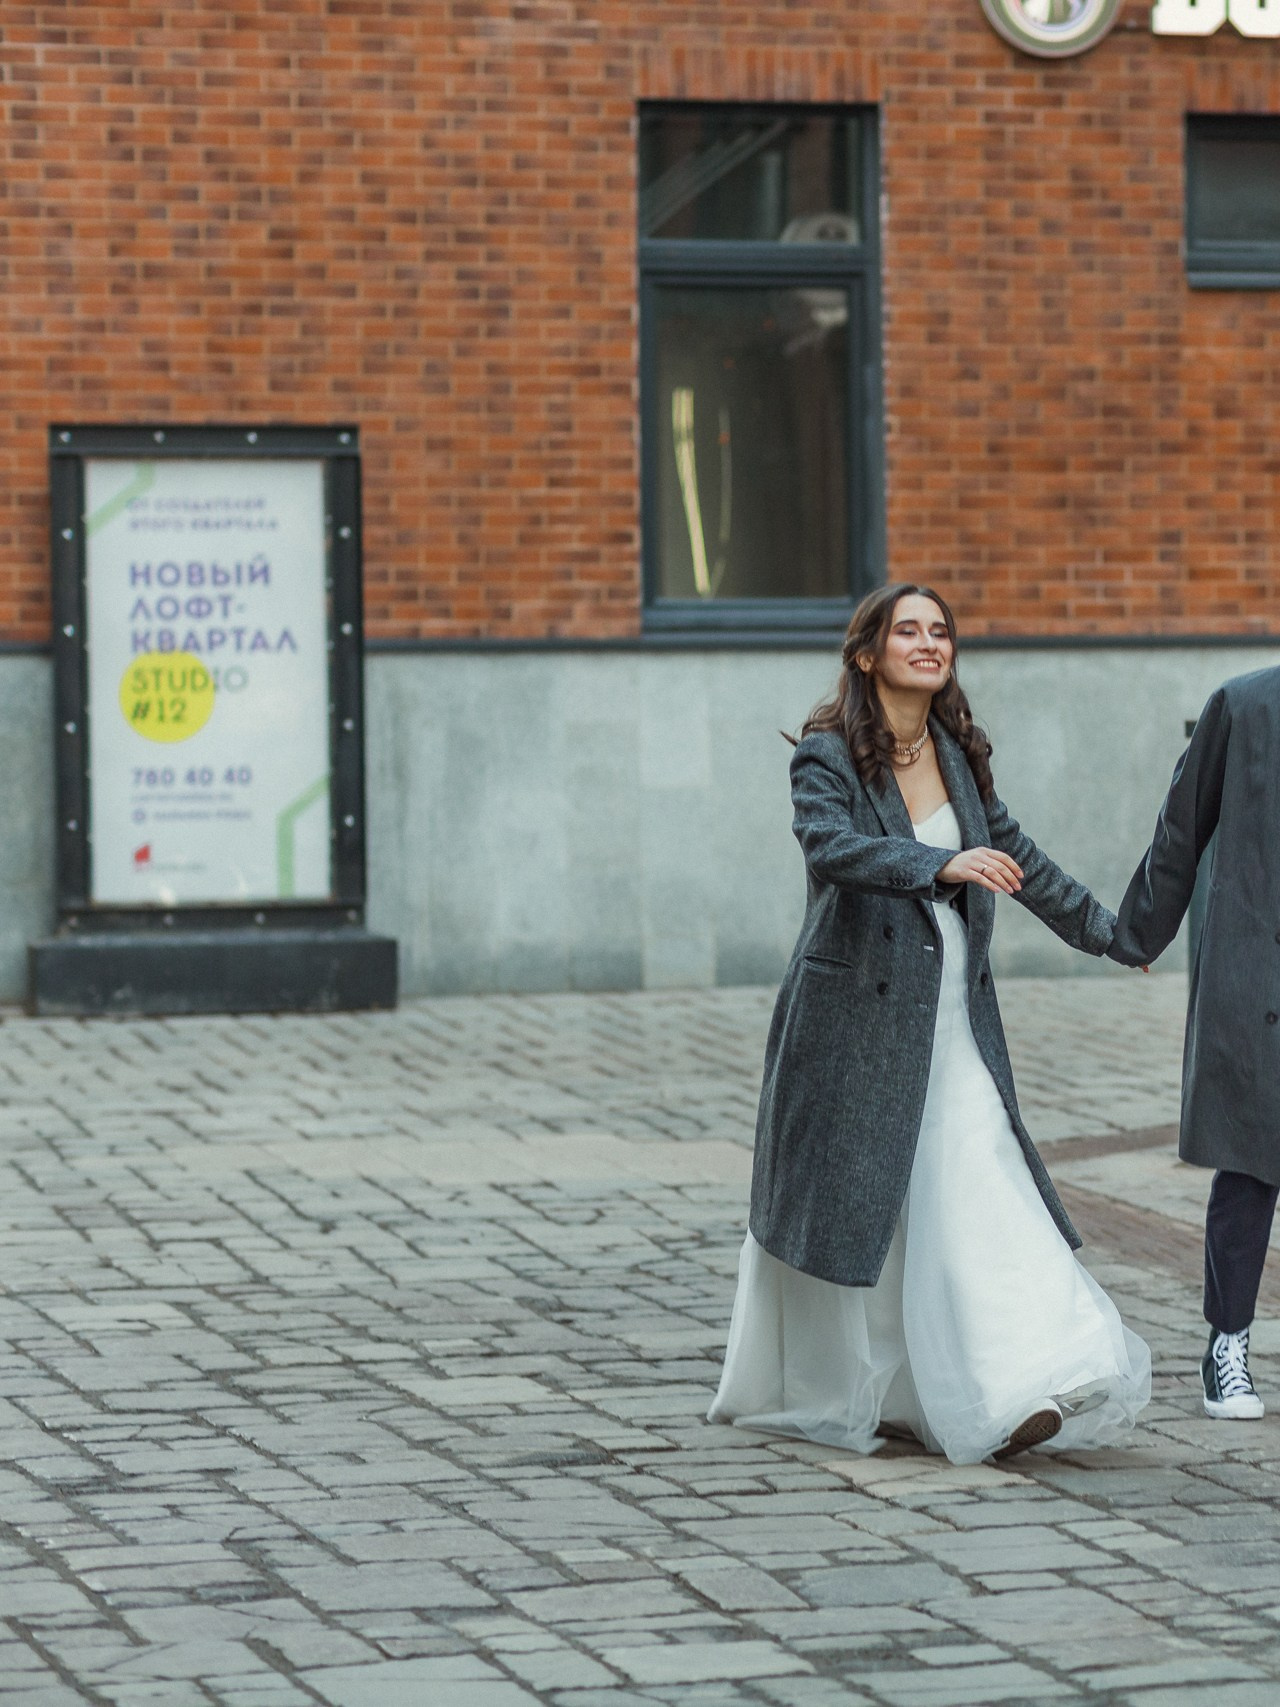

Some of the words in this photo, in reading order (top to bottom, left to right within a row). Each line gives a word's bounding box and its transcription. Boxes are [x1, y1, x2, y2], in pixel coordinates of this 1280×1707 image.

[130, 553, 271, 587] НОВЫЙ
[129, 594, 246, 621] ЛОФТ-
[131, 627, 297, 653] КВАРТАЛ
[132, 665, 249, 693] STUDIO
[131, 697, 187, 722] #12
[186, 767, 214, 786] 40
[223, 766, 252, 785] 40
